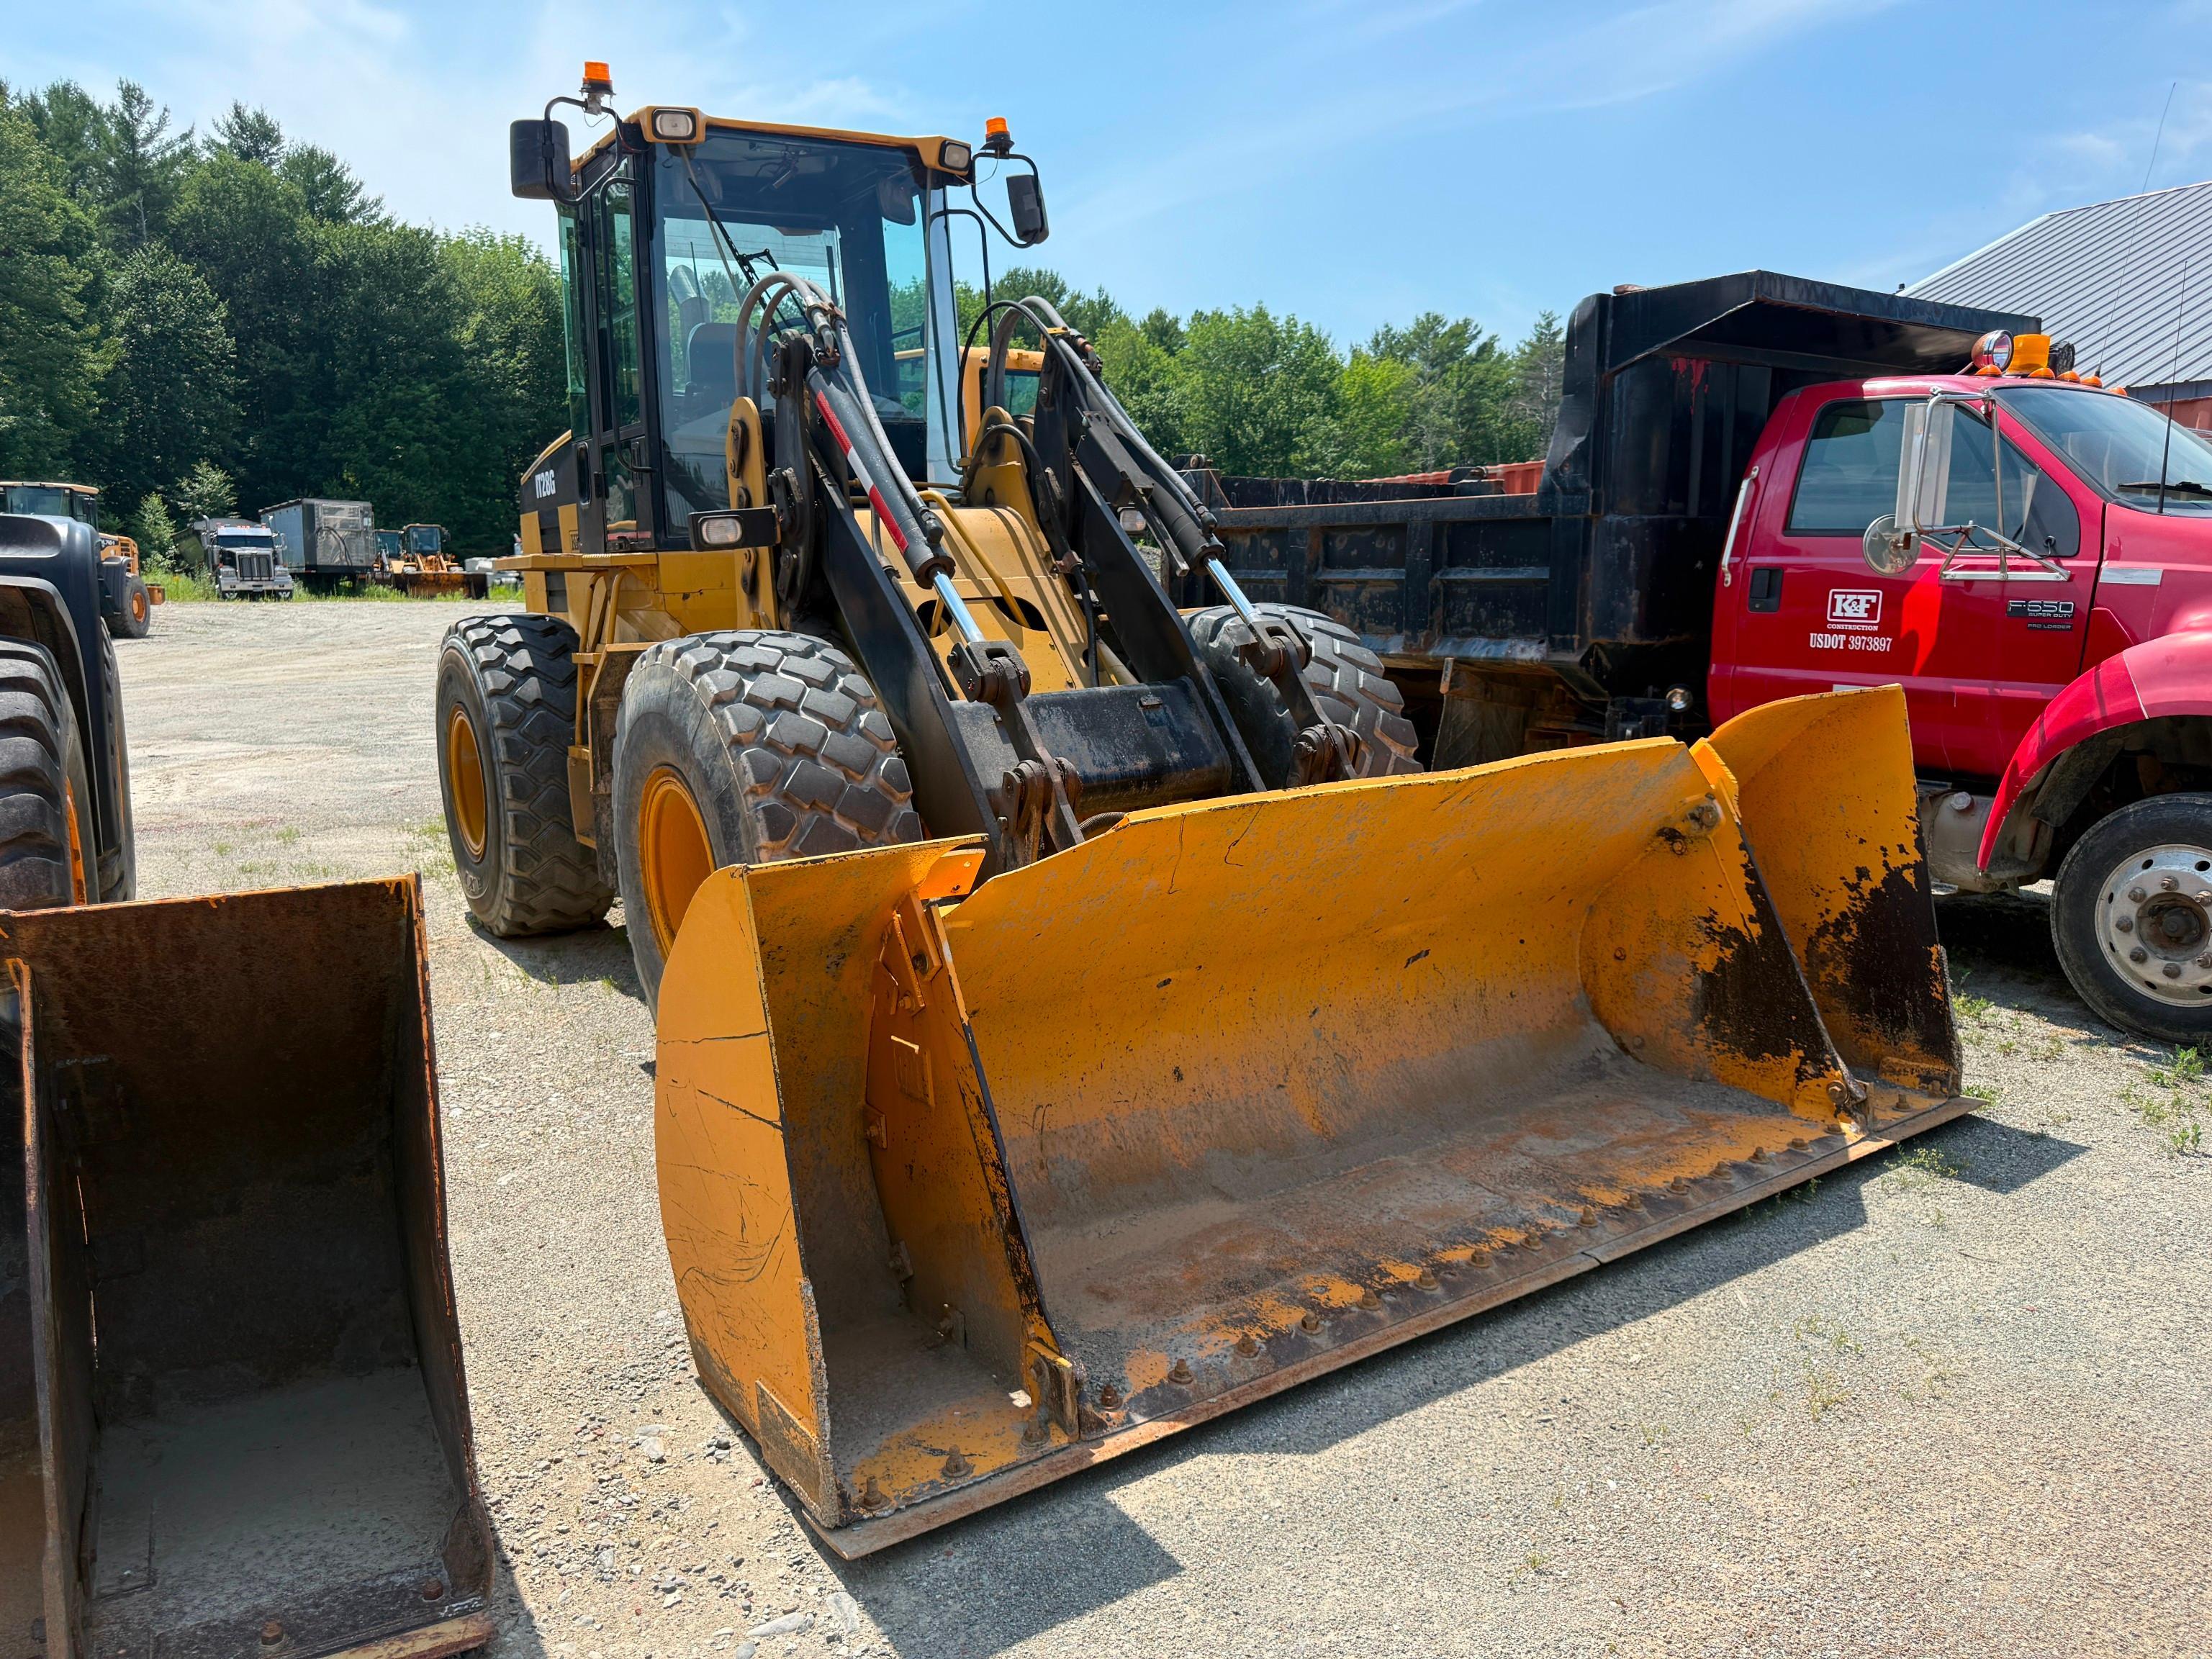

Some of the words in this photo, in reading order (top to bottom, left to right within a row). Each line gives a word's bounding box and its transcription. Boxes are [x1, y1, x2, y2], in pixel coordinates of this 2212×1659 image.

[535, 469, 556, 499] IT28G
[1832, 594, 1877, 618] K&F
[1810, 633, 1846, 649] USDOT
[1848, 636, 1893, 652] 3973897
